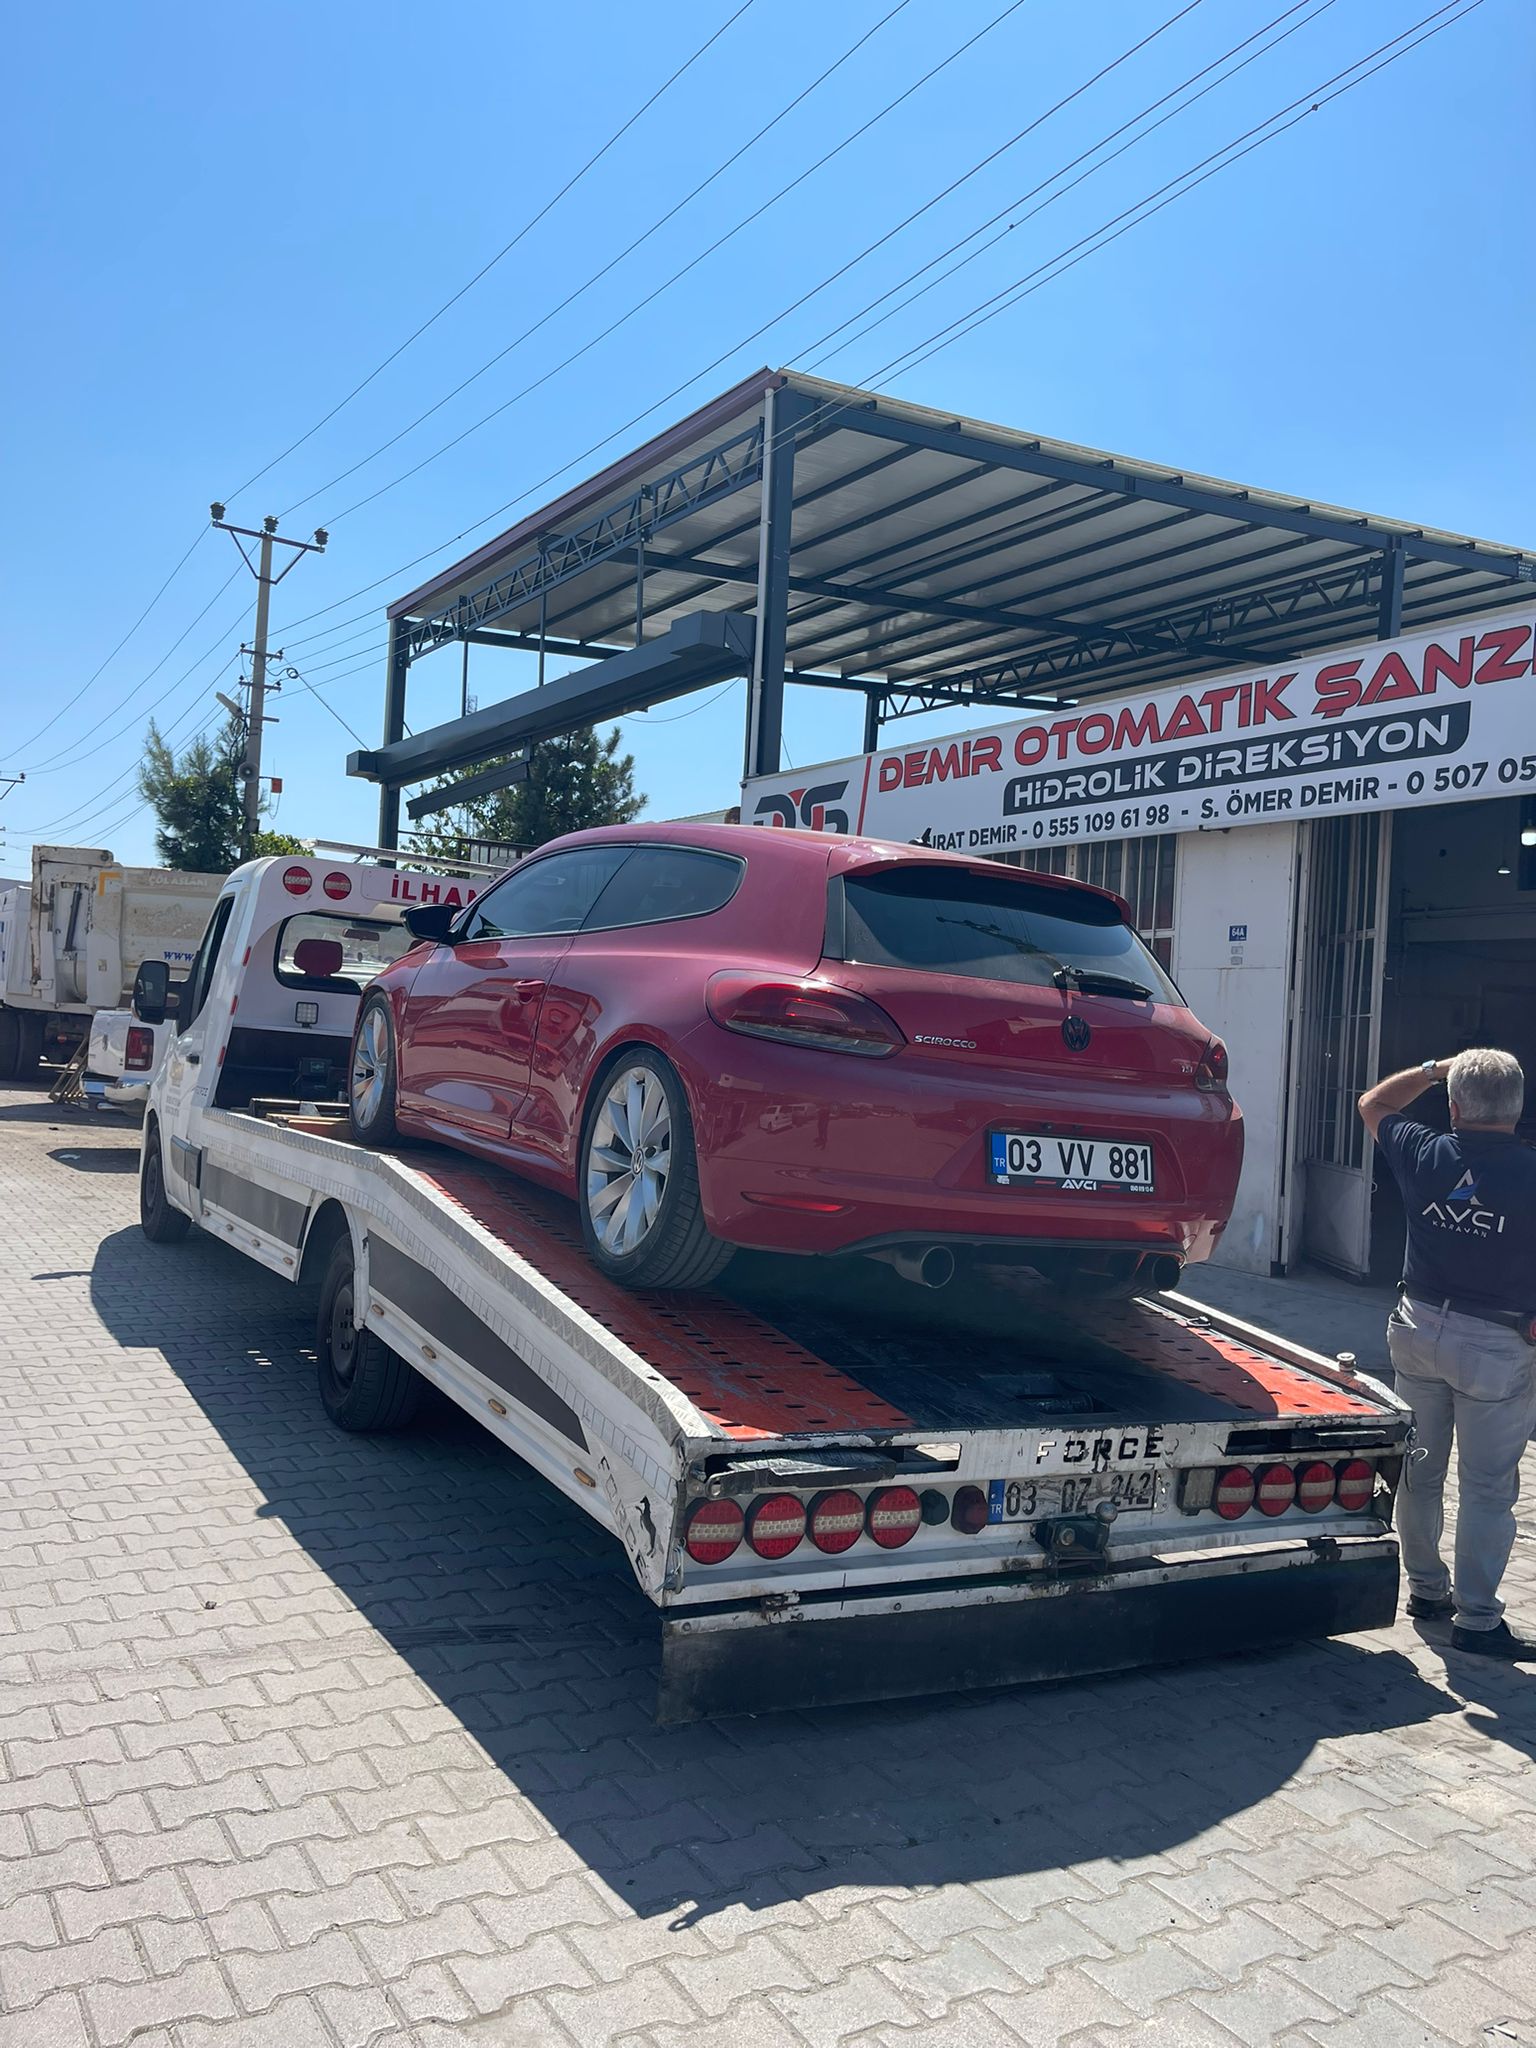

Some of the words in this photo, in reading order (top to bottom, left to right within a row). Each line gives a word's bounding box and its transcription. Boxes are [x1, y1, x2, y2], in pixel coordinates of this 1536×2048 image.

[878, 735, 1003, 793] DEMİR
[1014, 672, 1300, 766] OTOMATİK
[1311, 623, 1536, 719] ŞANZ
[1014, 760, 1165, 807] HİDROLİK
[1178, 714, 1450, 783] DİREKSİYON
[969, 824, 1017, 847] DEMİR
[1032, 821, 1044, 840] 0
[1048, 816, 1079, 838] 555
[1085, 812, 1115, 834] 109
[1121, 808, 1140, 830] 61
[1146, 804, 1170, 826] 98
[1200, 798, 1219, 819] S.
[1226, 789, 1293, 816] ÖMER
[1300, 776, 1380, 807] DEMİR
[1406, 770, 1424, 795] 0
[1433, 761, 1489, 792] 507
[1497, 755, 1536, 784] 05
[914, 1034, 977, 1049] SCIROCCO
[993, 1157, 1006, 1168] TR
[1008, 1138, 1042, 1173] 03
[1057, 1141, 1095, 1177] VV
[1109, 1146, 1149, 1181] 881
[1061, 1178, 1097, 1191] AVCI
[1422, 1201, 1505, 1233] AVCI
[1432, 1219, 1488, 1239] KARAVAN
[1035, 1436, 1164, 1465] FORCE
[990, 1503, 1002, 1515] TR
[1005, 1480, 1037, 1516] 03
[1111, 1472, 1151, 1507] 242
